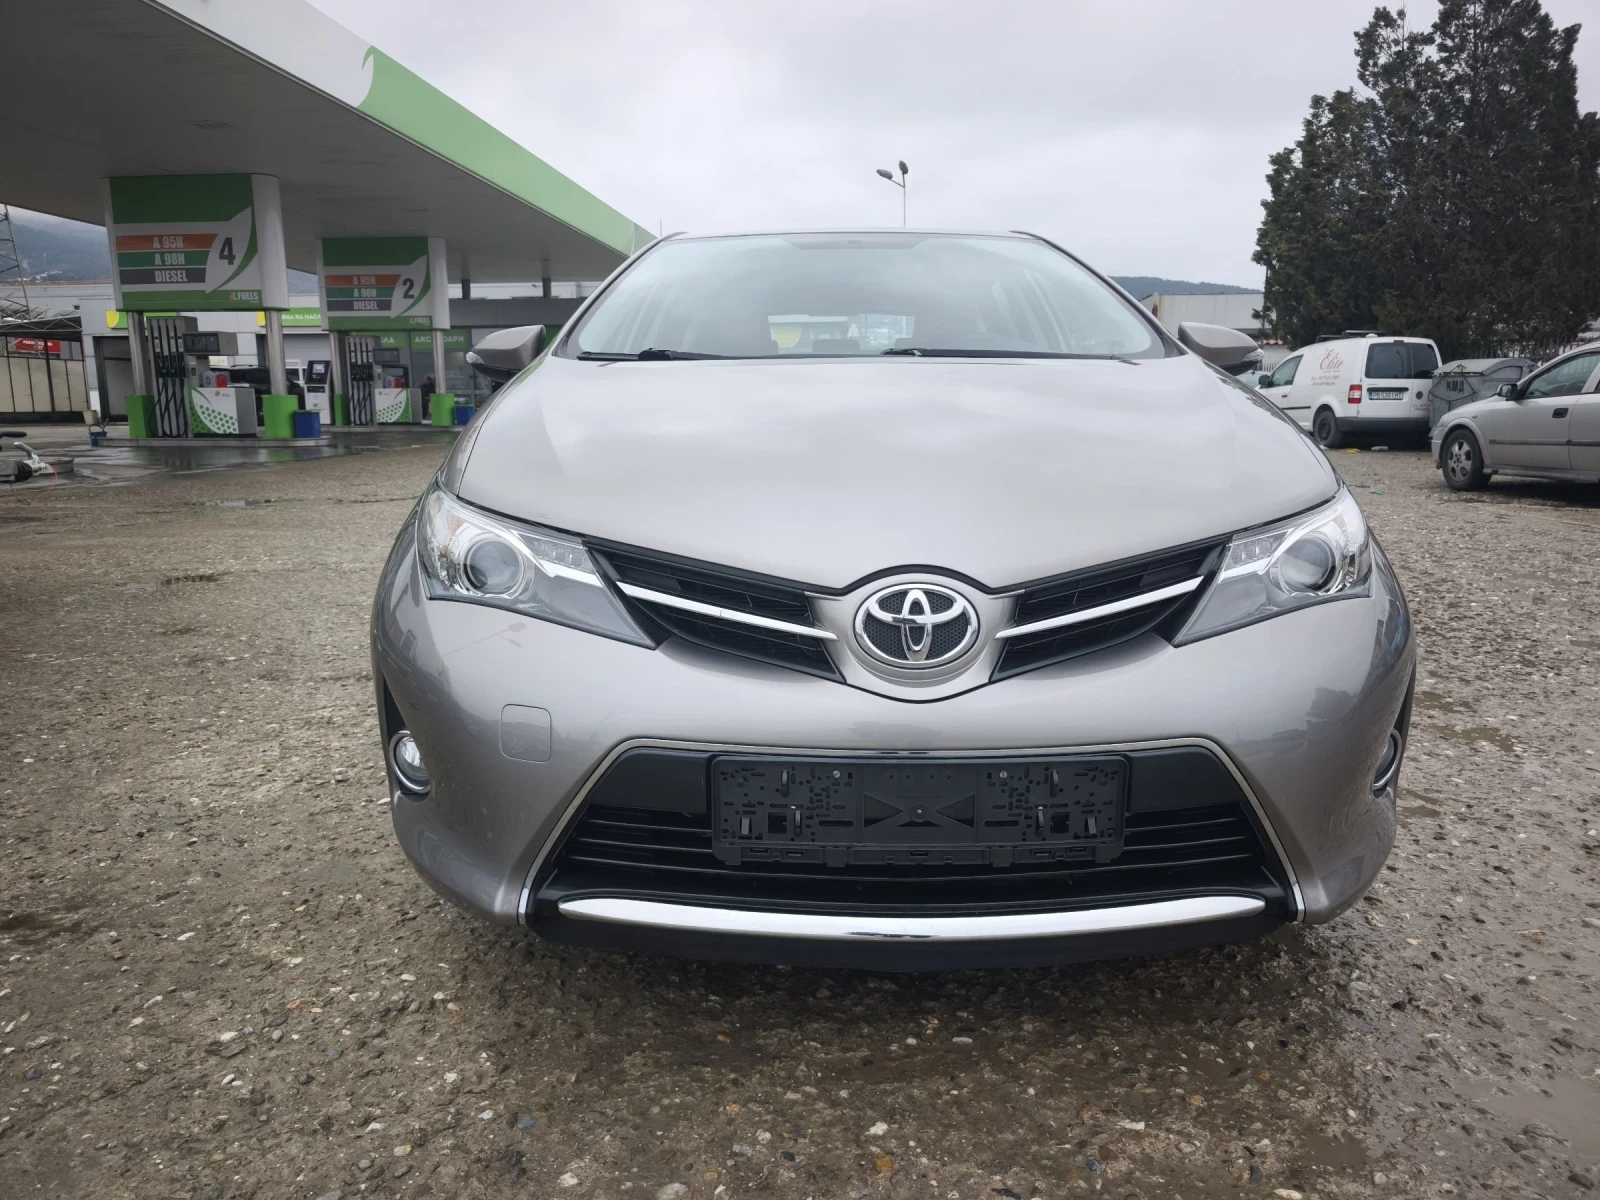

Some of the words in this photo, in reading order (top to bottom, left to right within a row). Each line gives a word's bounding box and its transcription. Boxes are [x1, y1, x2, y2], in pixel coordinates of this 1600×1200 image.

[218, 237, 236, 265] 4
[155, 270, 188, 283] DIESEL
[402, 278, 415, 299] 2
[353, 301, 379, 310] DIESEL
